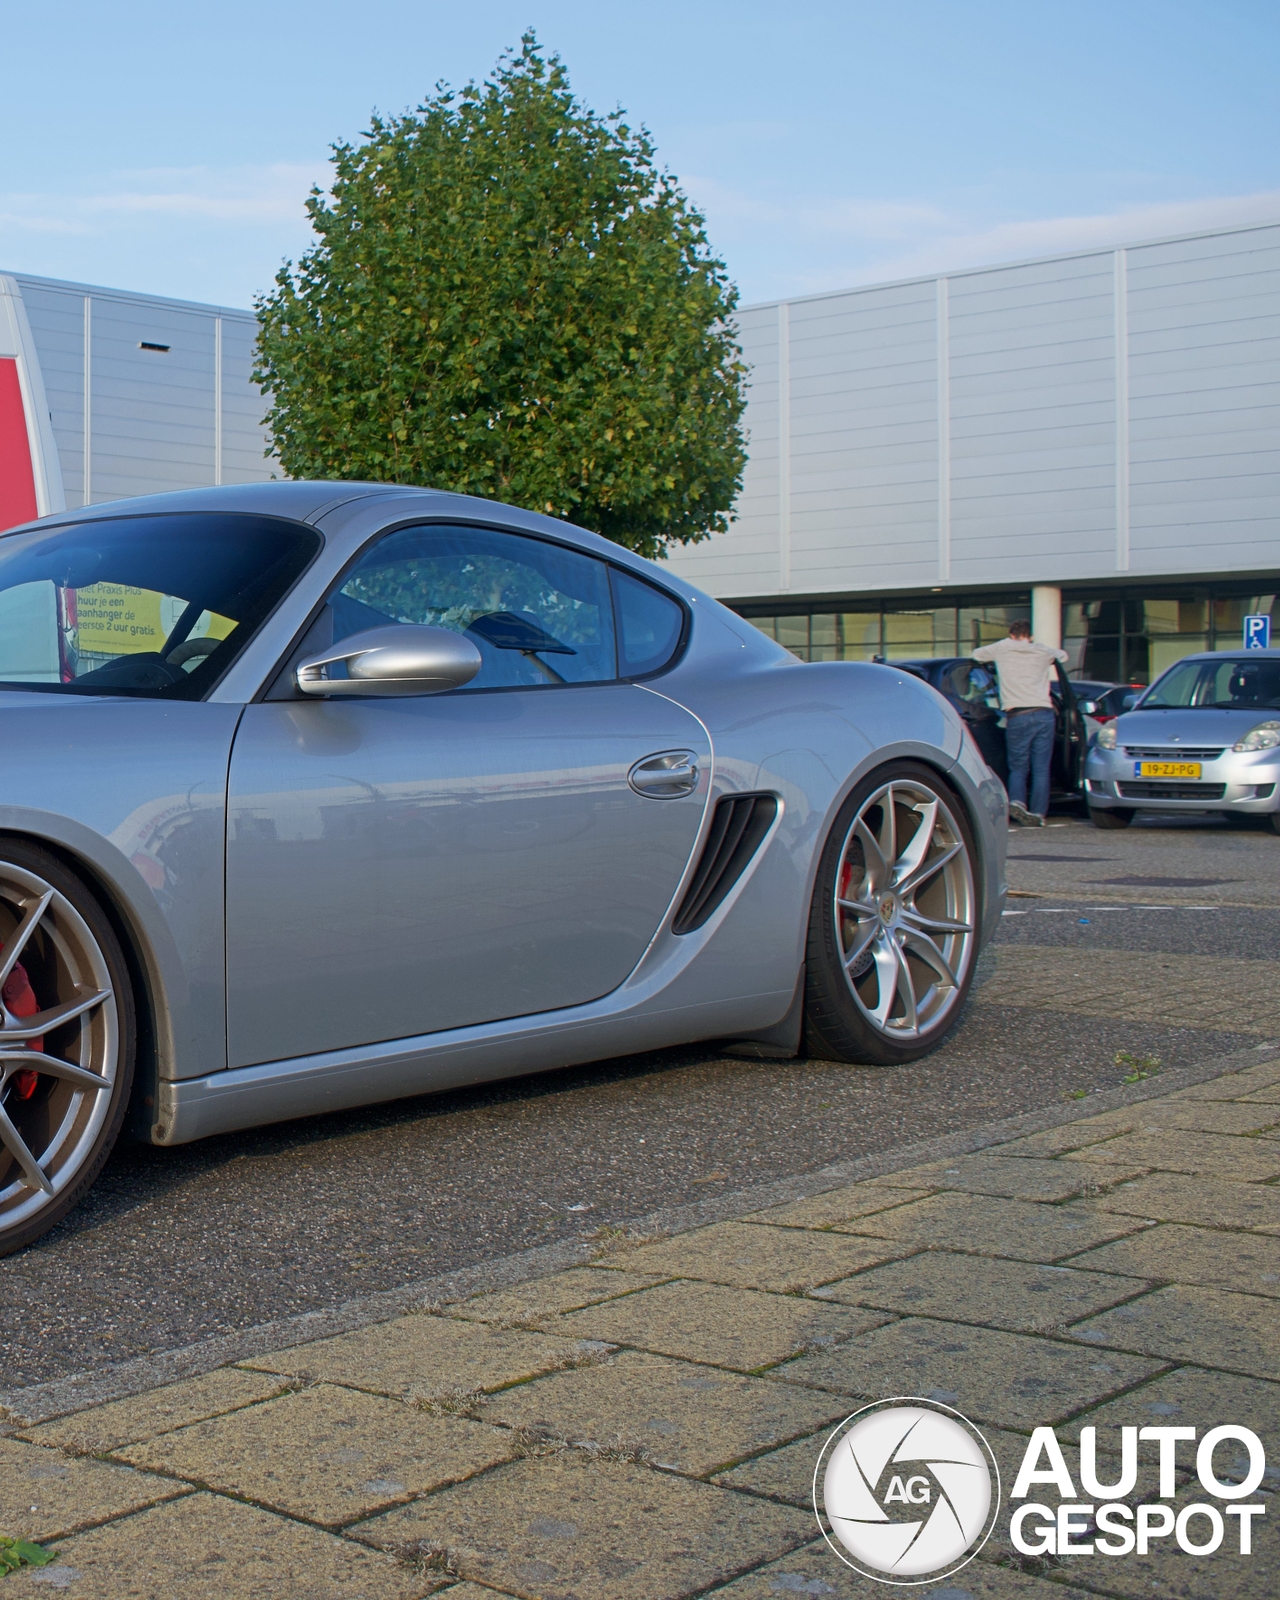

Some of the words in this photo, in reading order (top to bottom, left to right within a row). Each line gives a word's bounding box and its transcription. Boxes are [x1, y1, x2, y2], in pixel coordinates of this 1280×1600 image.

[98, 583, 122, 595] Praxis
[124, 585, 142, 595] Plus
[78, 596, 97, 606] huur
[99, 598, 107, 607] je
[109, 599, 124, 607] een
[78, 608, 123, 621] aanhanger
[125, 610, 135, 620] de
[78, 622, 104, 630] eerste
[106, 622, 112, 630] 2
[114, 624, 128, 632] uur
[130, 625, 156, 636] gratis.
[1250, 619, 1264, 637] P
[1147, 764, 1194, 775] 19-ZJ-PG
